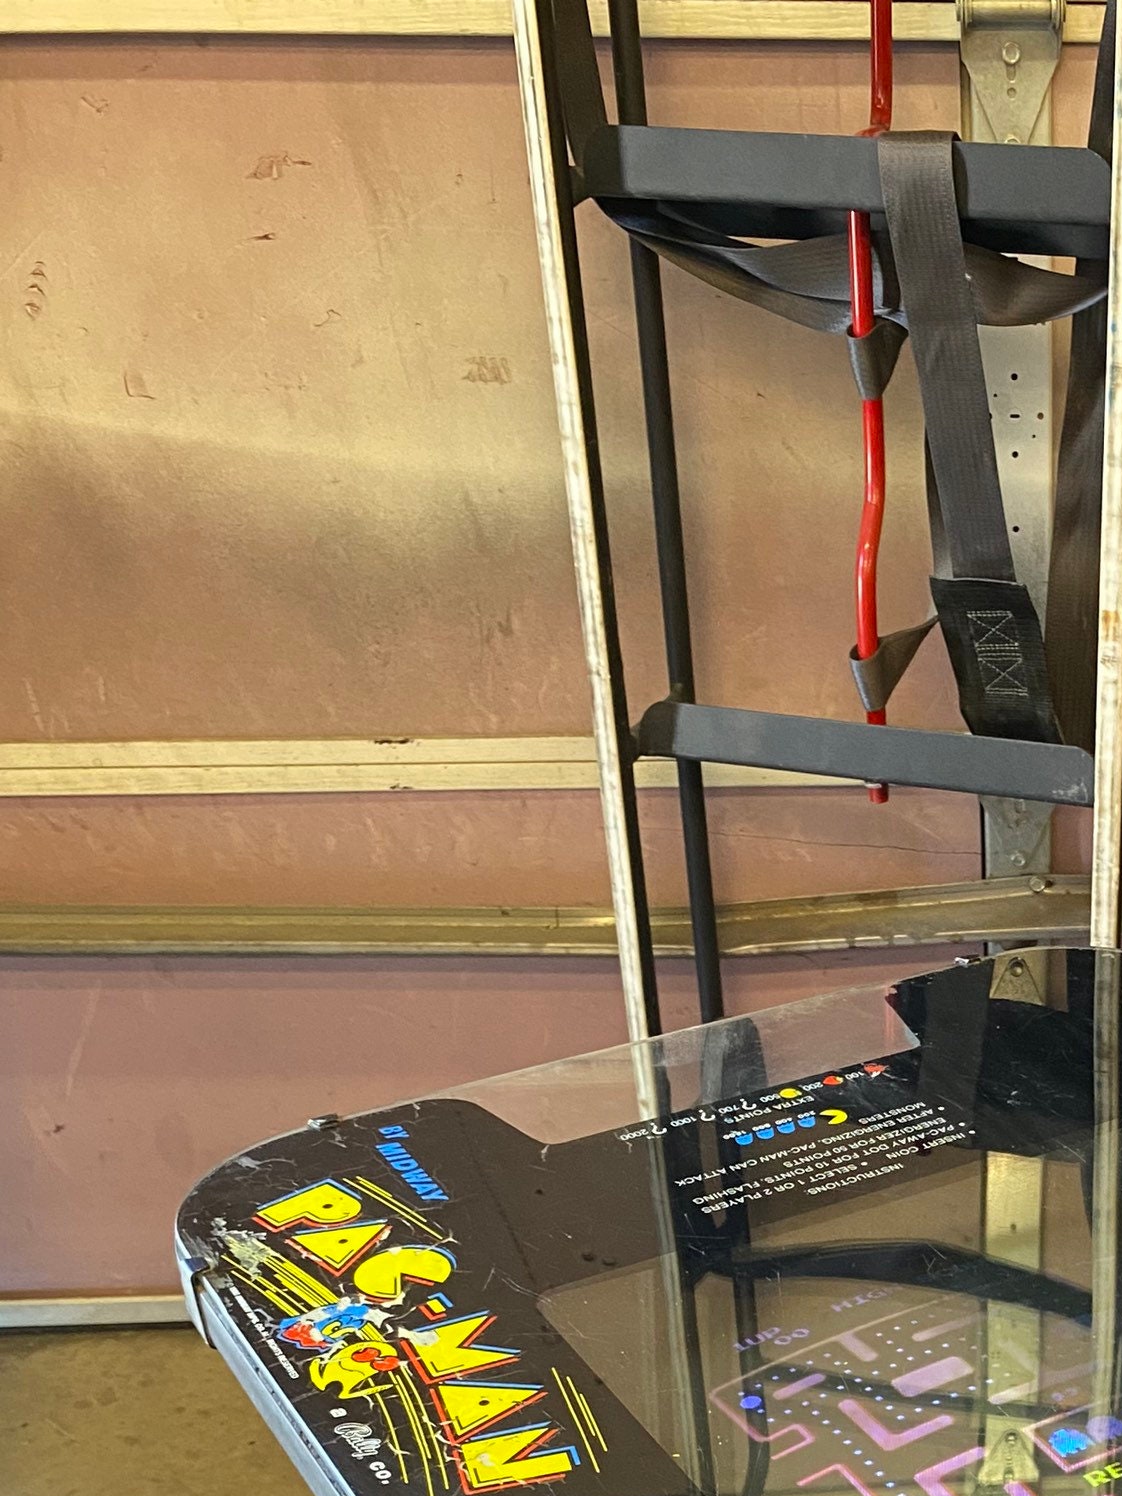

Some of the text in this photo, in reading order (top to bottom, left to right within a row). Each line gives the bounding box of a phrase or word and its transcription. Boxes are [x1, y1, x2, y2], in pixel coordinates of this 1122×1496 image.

[723, 1095, 815, 1125] EXTRA POINTS
[858, 1101, 927, 1125] MONSTERS
[897, 1109, 933, 1124] AFTER
[878, 1117, 947, 1141] ENERGIZER
[892, 1124, 955, 1148] PAC-AWAY
[760, 1142, 817, 1163] PAC-MAN
[848, 1137, 877, 1149] FOR
[864, 1144, 888, 1156] DOT
[886, 1132, 966, 1160] INSERT COIN
[375, 1125, 450, 1200] BY MIDWAY
[730, 1159, 758, 1172] CAN
[782, 1149, 832, 1168] POINTS
[814, 1161, 830, 1169] 10
[832, 1152, 860, 1164] FOR
[674, 1168, 727, 1187] ATTACK
[809, 1162, 858, 1183] SELECT
[692, 1181, 760, 1205] FLASHING
[762, 1187, 773, 1195] 2
[774, 1182, 795, 1193] OR
[701, 1191, 762, 1214] PLAYERS
[369, 1461, 392, 1485] CO.
